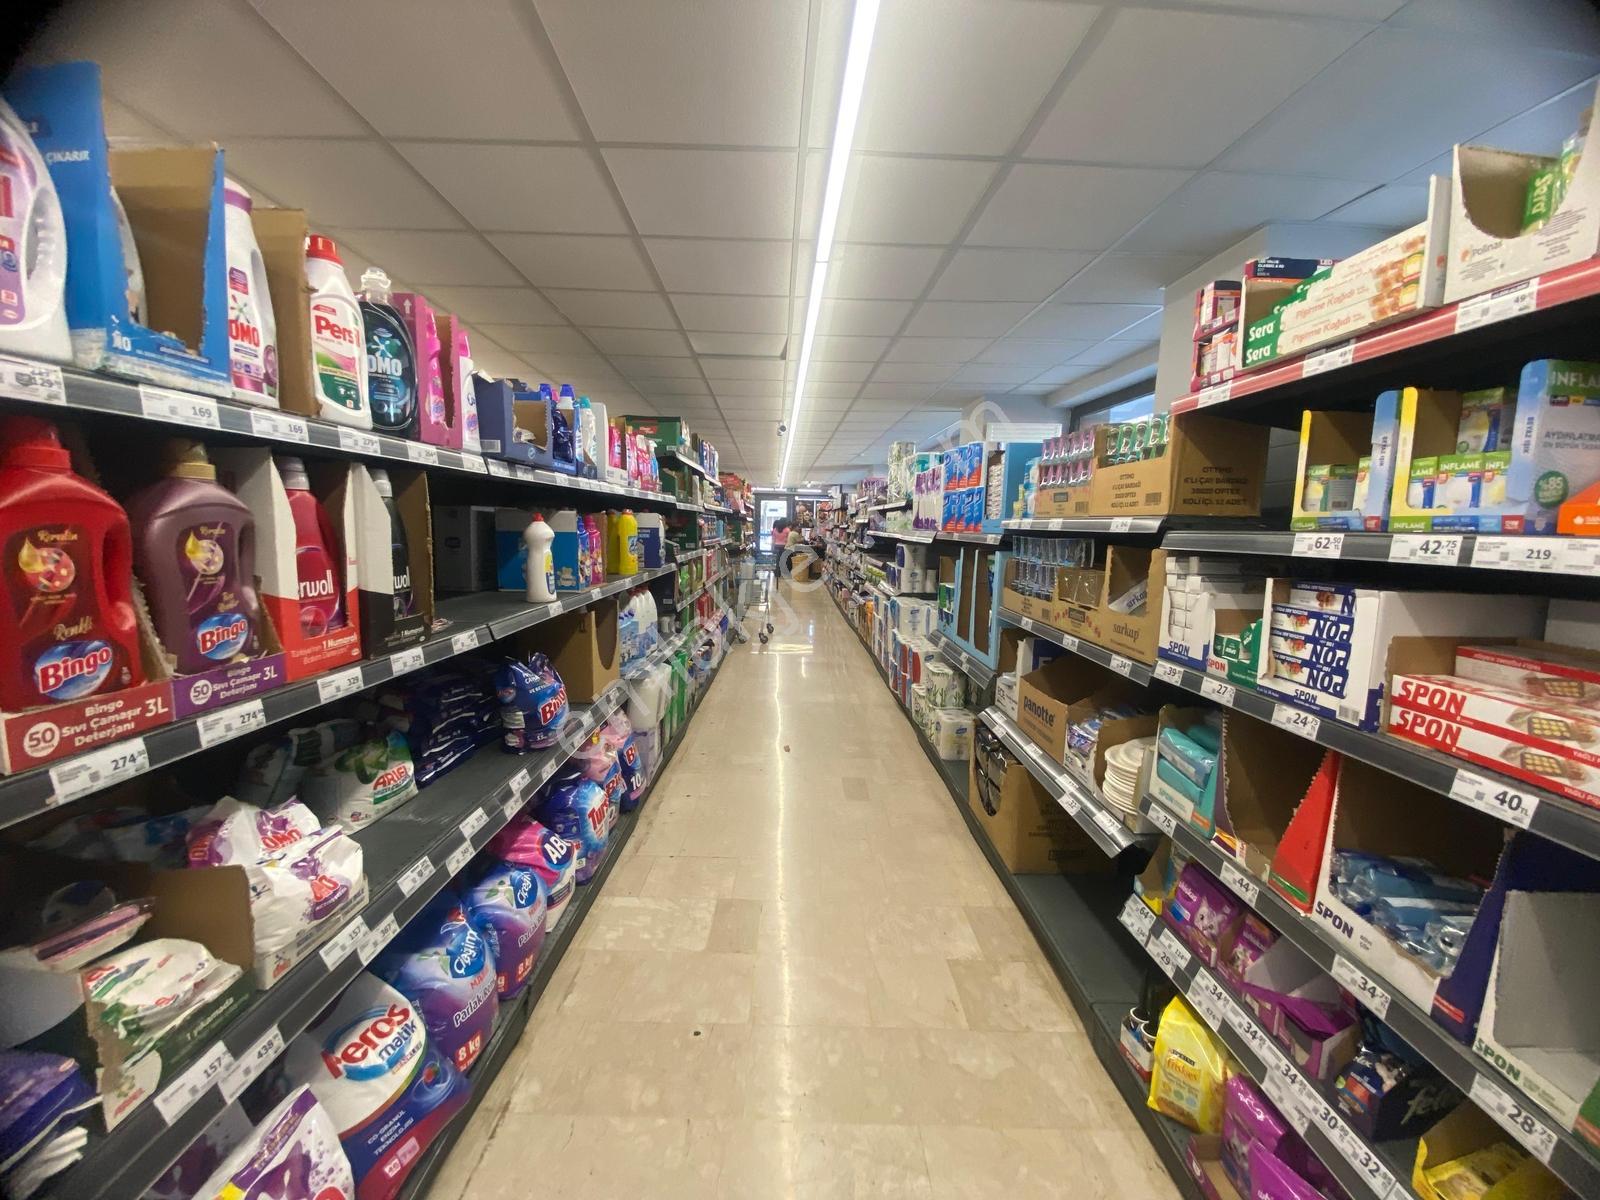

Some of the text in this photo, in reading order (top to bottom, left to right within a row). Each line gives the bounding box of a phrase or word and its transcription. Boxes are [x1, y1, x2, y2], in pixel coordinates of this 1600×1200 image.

[1248, 321, 1275, 342] Sera
[1245, 343, 1272, 364] Sera
[367, 353, 402, 377] OMO
[191, 405, 213, 418] 169
[1411, 466, 1435, 479] LAME
[1439, 461, 1481, 473] INFLAME
[1525, 547, 1552, 560] 219
[298, 569, 334, 599] rwoll
[200, 618, 247, 654] Bingo
[1168, 640, 1190, 657] SPON
[39, 645, 113, 693] Bingo
[263, 665, 278, 681] 3L
[1207, 658, 1226, 672] SPON
[193, 683, 209, 697] 50
[1293, 688, 1318, 704] SPON
[1400, 680, 1467, 719] SPON
[85, 700, 124, 717] Bingo
[145, 697, 168, 718] 3L
[28, 728, 56, 749] 50
[1398, 709, 1462, 748] SPON
[1494, 790, 1522, 811] 40
[1314, 899, 1355, 940] SPON
[1159, 951, 1171, 966] 29
[378, 1018, 417, 1061] matik
[203, 1055, 224, 1078] 157
[1474, 1037, 1521, 1081] SPON
